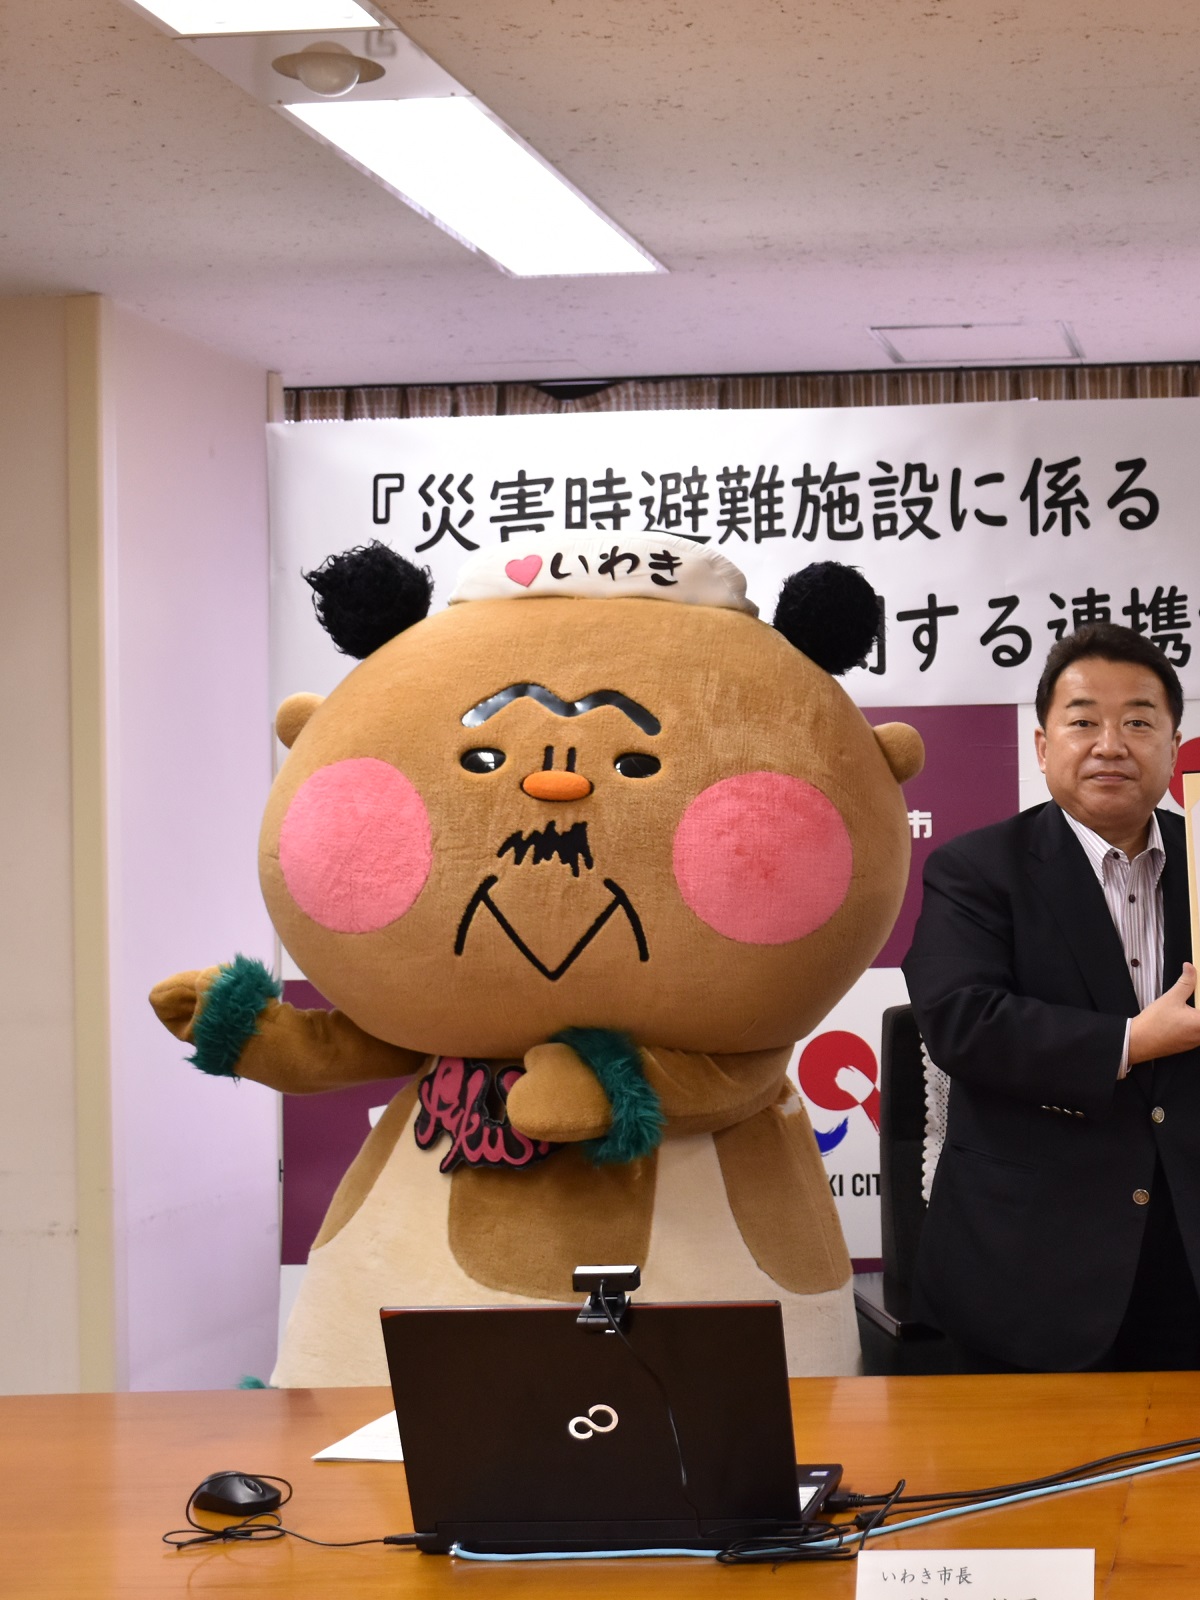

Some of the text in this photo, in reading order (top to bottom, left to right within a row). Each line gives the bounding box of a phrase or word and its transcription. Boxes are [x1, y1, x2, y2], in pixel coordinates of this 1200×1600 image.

[372, 456, 1161, 553] 『災害時避難施設に係る
[550, 546, 683, 587] いわき
[881, 1566, 973, 1586] いわき市長
